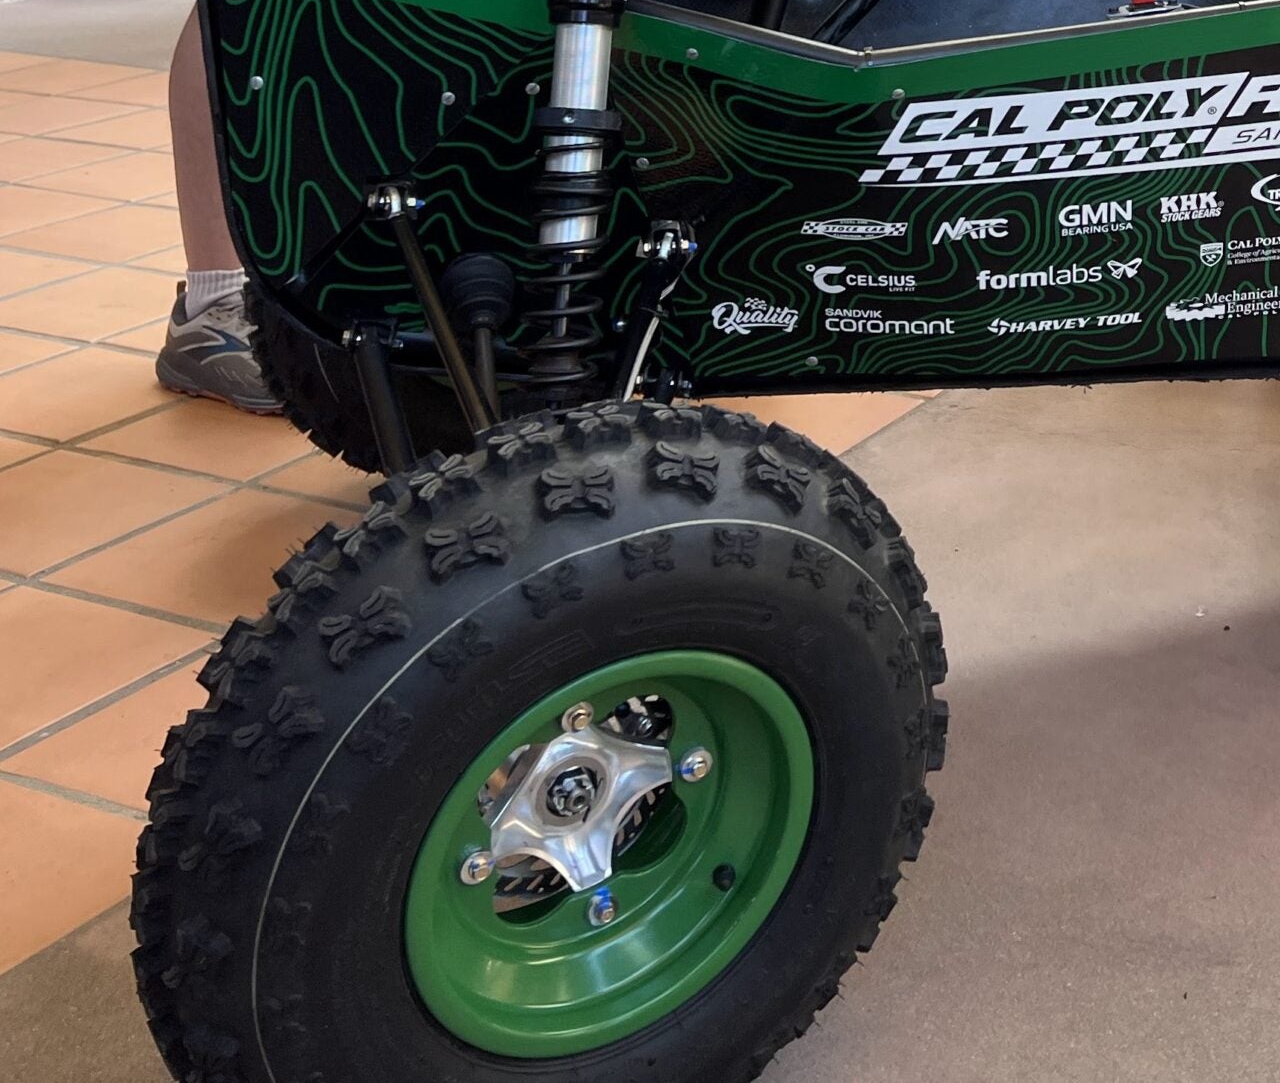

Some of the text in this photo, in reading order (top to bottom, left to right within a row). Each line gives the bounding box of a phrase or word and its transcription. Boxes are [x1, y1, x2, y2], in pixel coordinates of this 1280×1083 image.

[898, 104, 1030, 145] CAL
[1044, 82, 1230, 132] POLY
[1160, 191, 1218, 214] KHK
[1058, 199, 1133, 226] GMN
[1160, 207, 1222, 223] STOCK GEARS
[1061, 221, 1134, 237] BEARING USA
[1227, 239, 1254, 251] CAL
[1227, 251, 1252, 259] College
[845, 274, 917, 287] CELSIUS
[975, 263, 1103, 290] formlabs
[1204, 285, 1279, 305] Mechanical
[711, 300, 799, 335] Quality
[824, 307, 882, 319] SANDVIK
[824, 317, 955, 335] coromant
[1009, 312, 1143, 334] HARVEY TOOL
